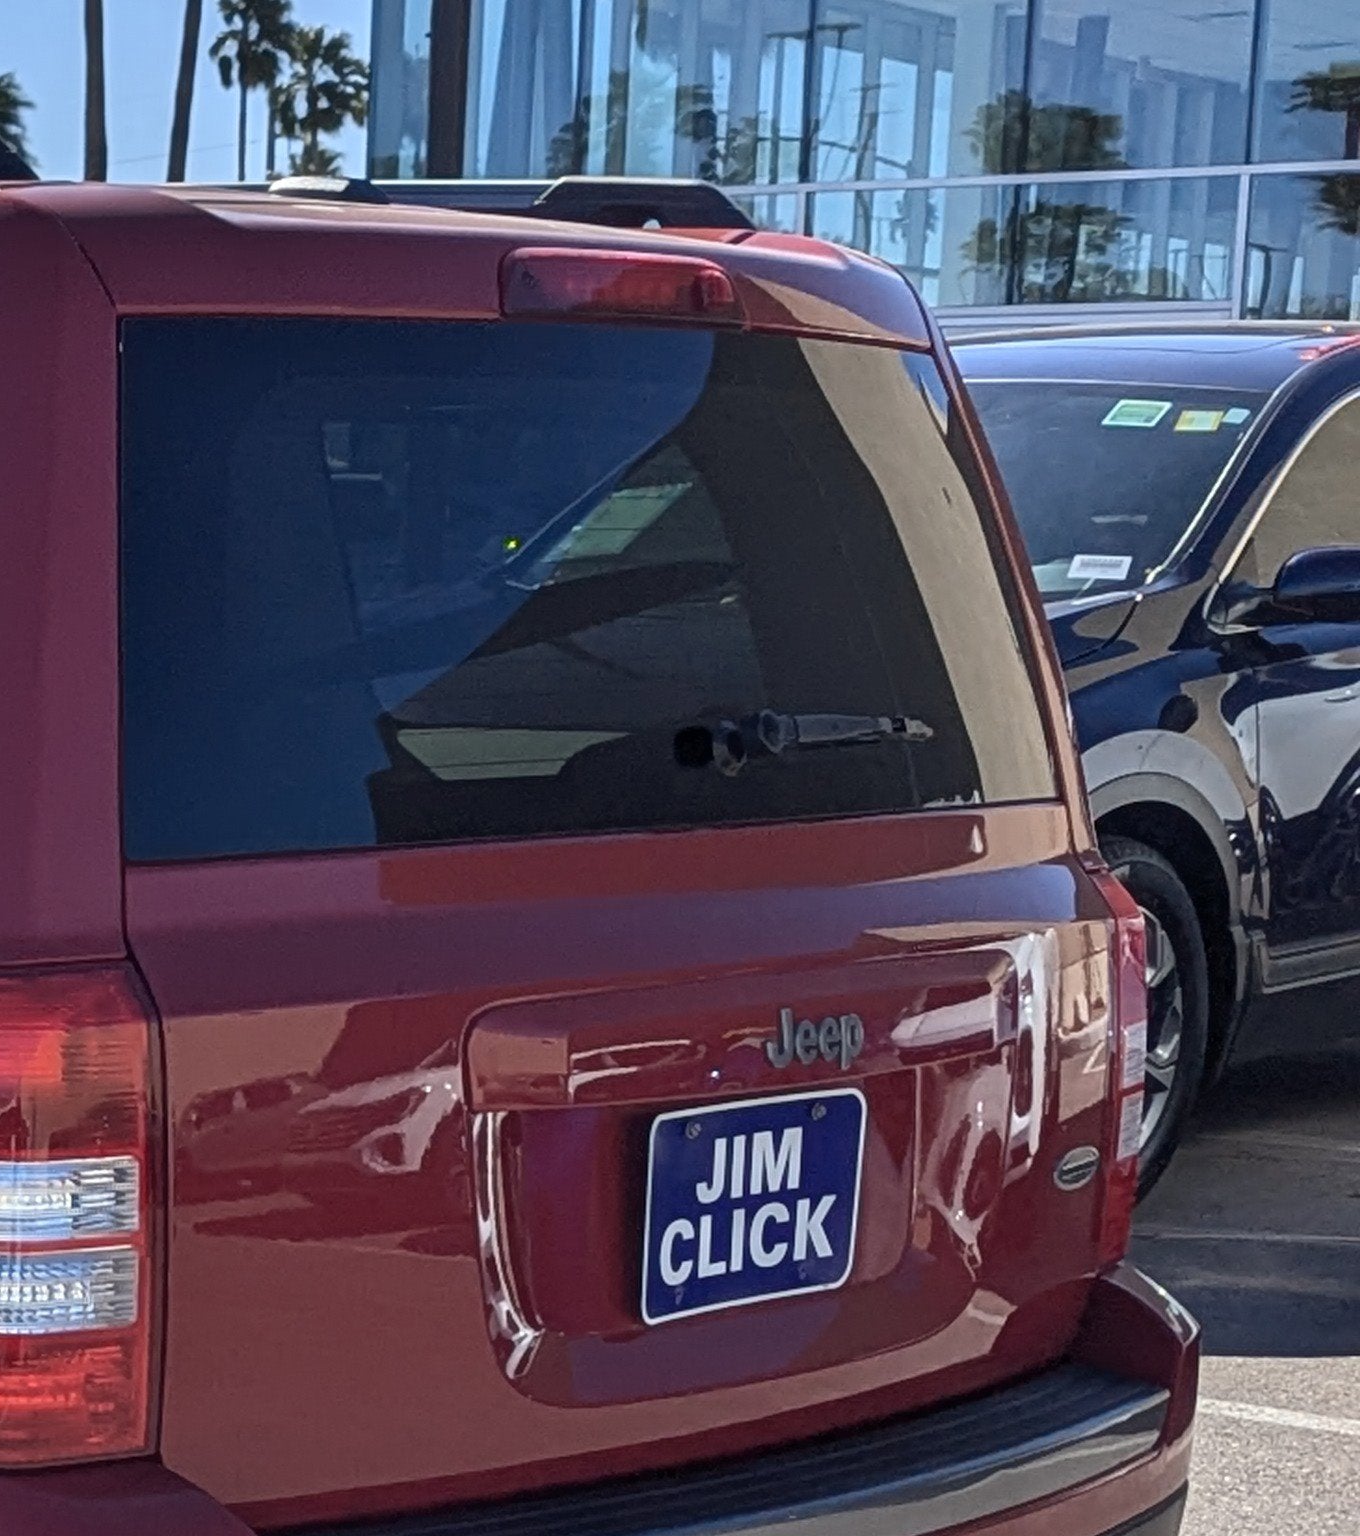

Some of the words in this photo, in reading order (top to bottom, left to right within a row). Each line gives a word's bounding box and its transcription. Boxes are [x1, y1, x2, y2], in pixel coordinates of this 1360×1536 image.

[766, 1008, 865, 1070] Jeep
[695, 1126, 804, 1205] JIM
[659, 1194, 838, 1287] CLICK
